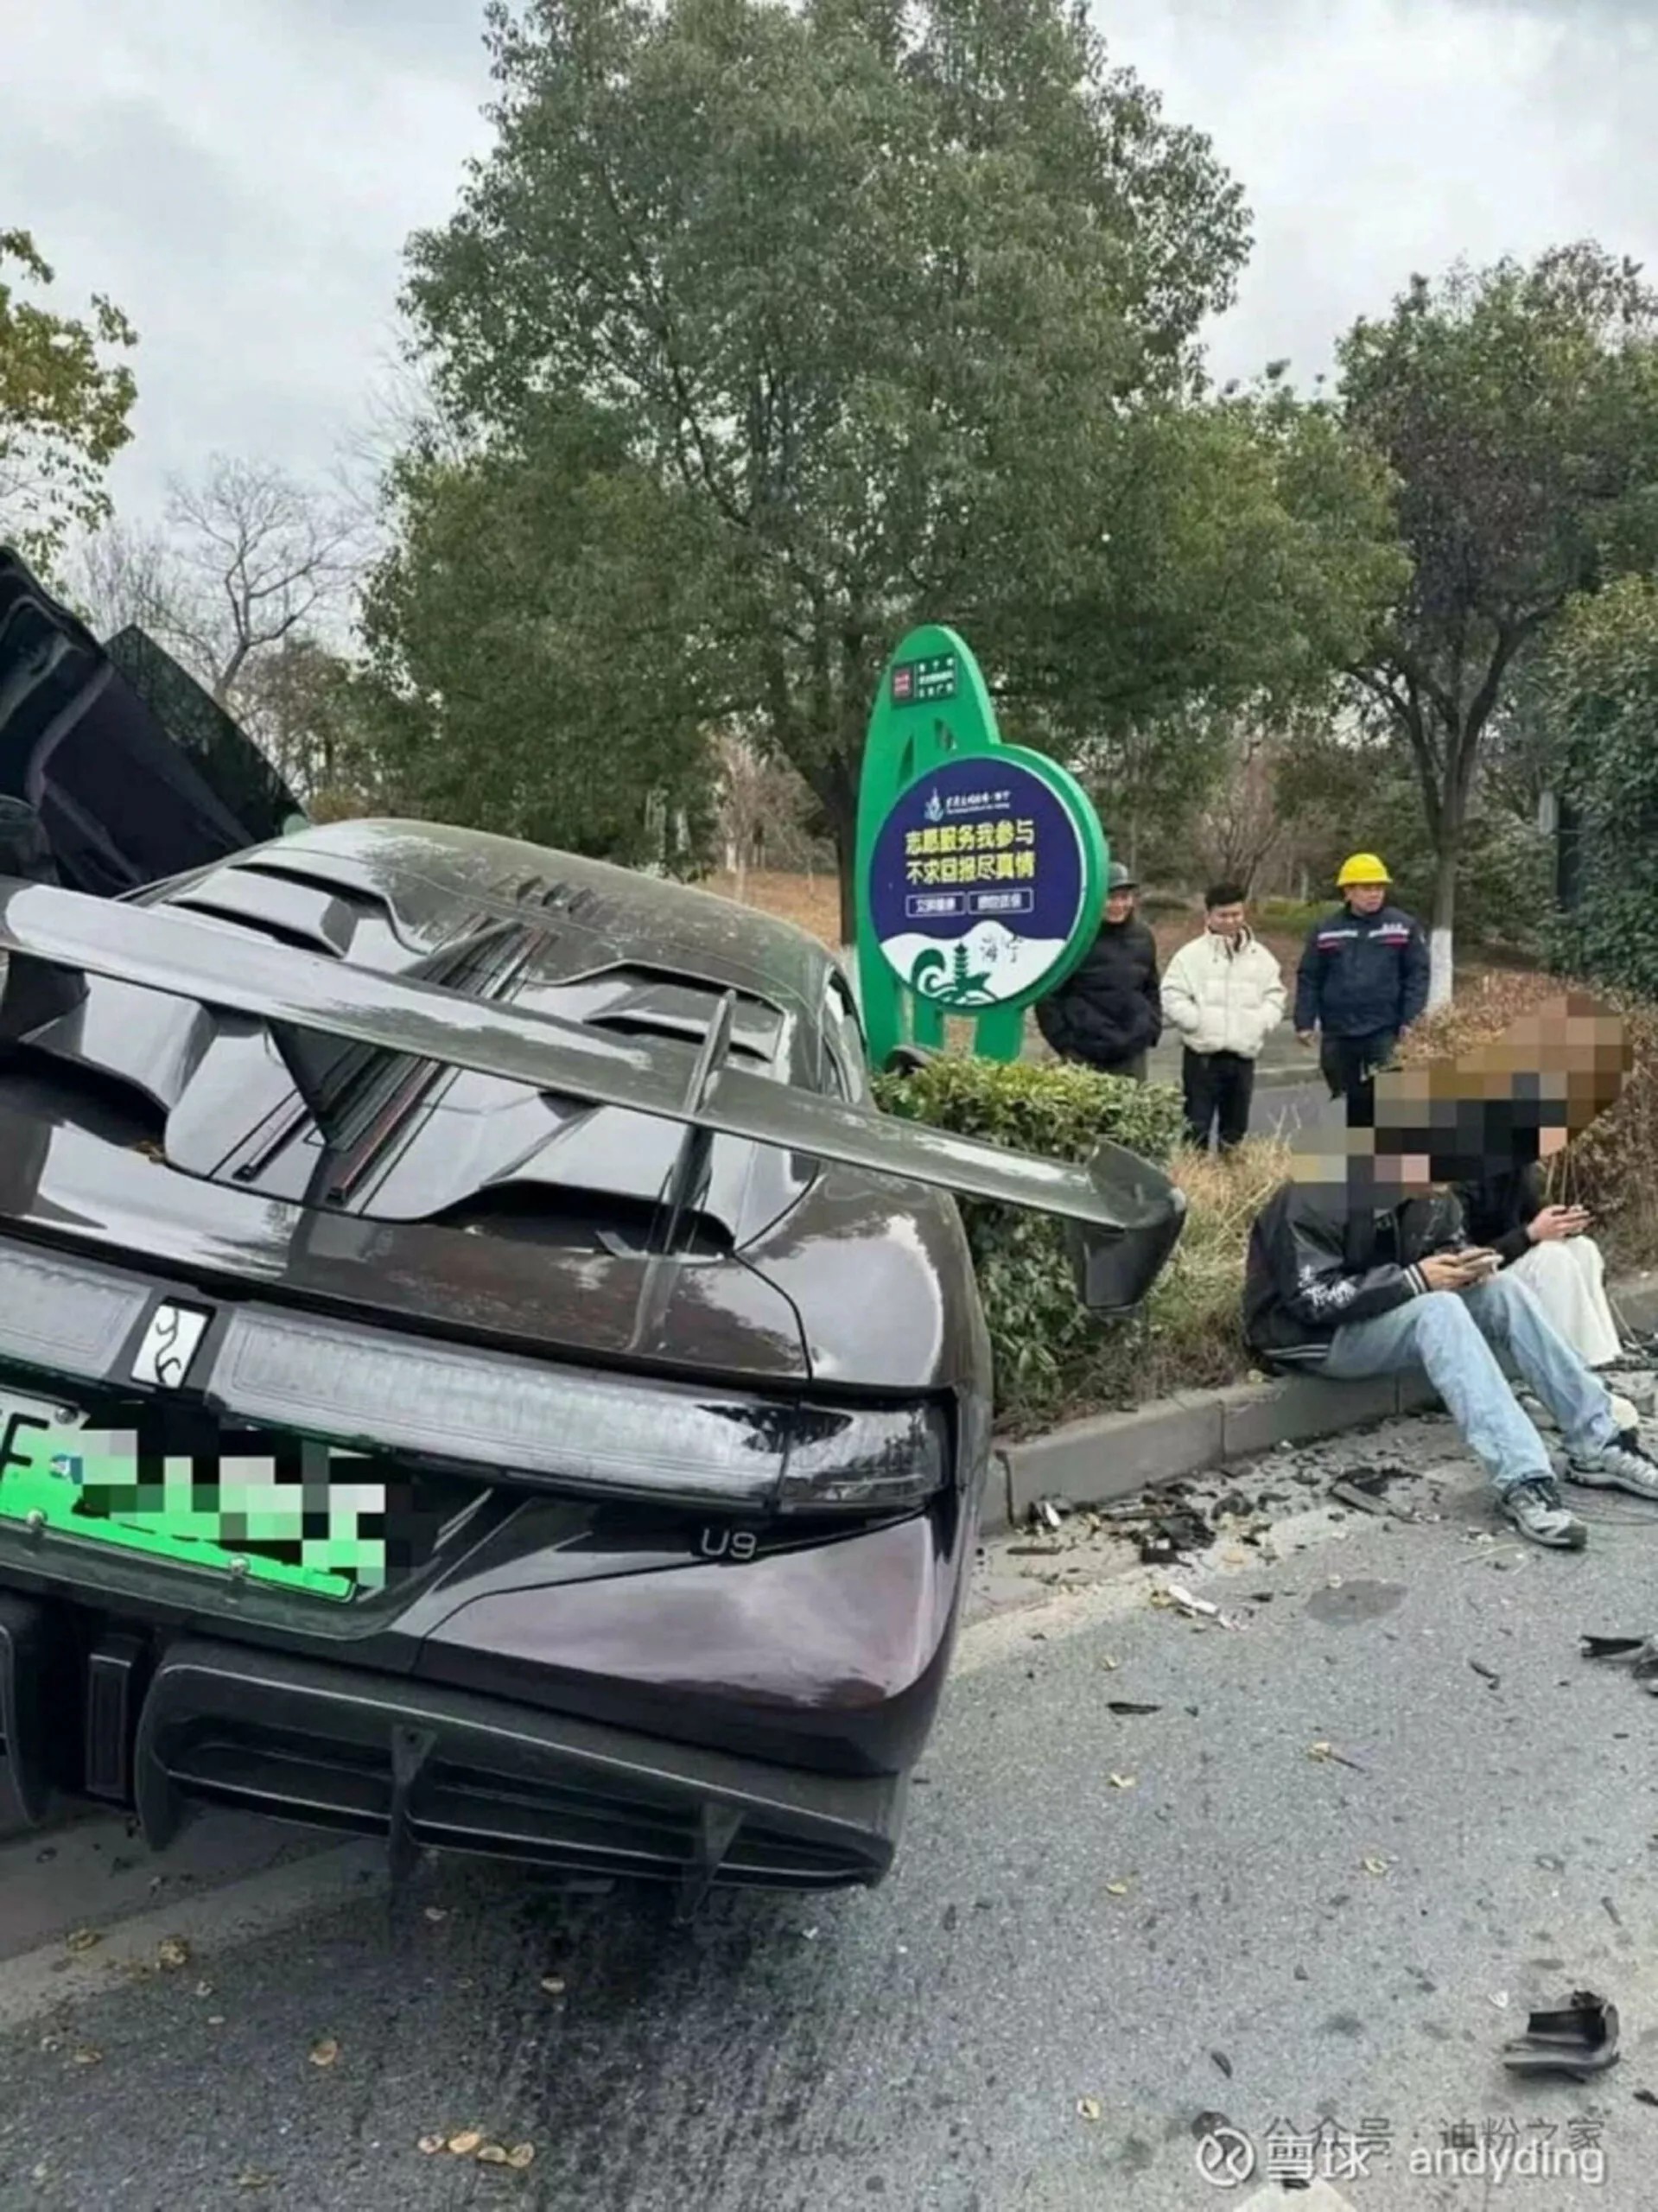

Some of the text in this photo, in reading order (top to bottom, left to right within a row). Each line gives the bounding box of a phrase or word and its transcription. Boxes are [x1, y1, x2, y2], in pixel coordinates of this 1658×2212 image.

[905, 850, 1035, 886] 不求回报尽真情
[701, 1528, 757, 1560] U9
